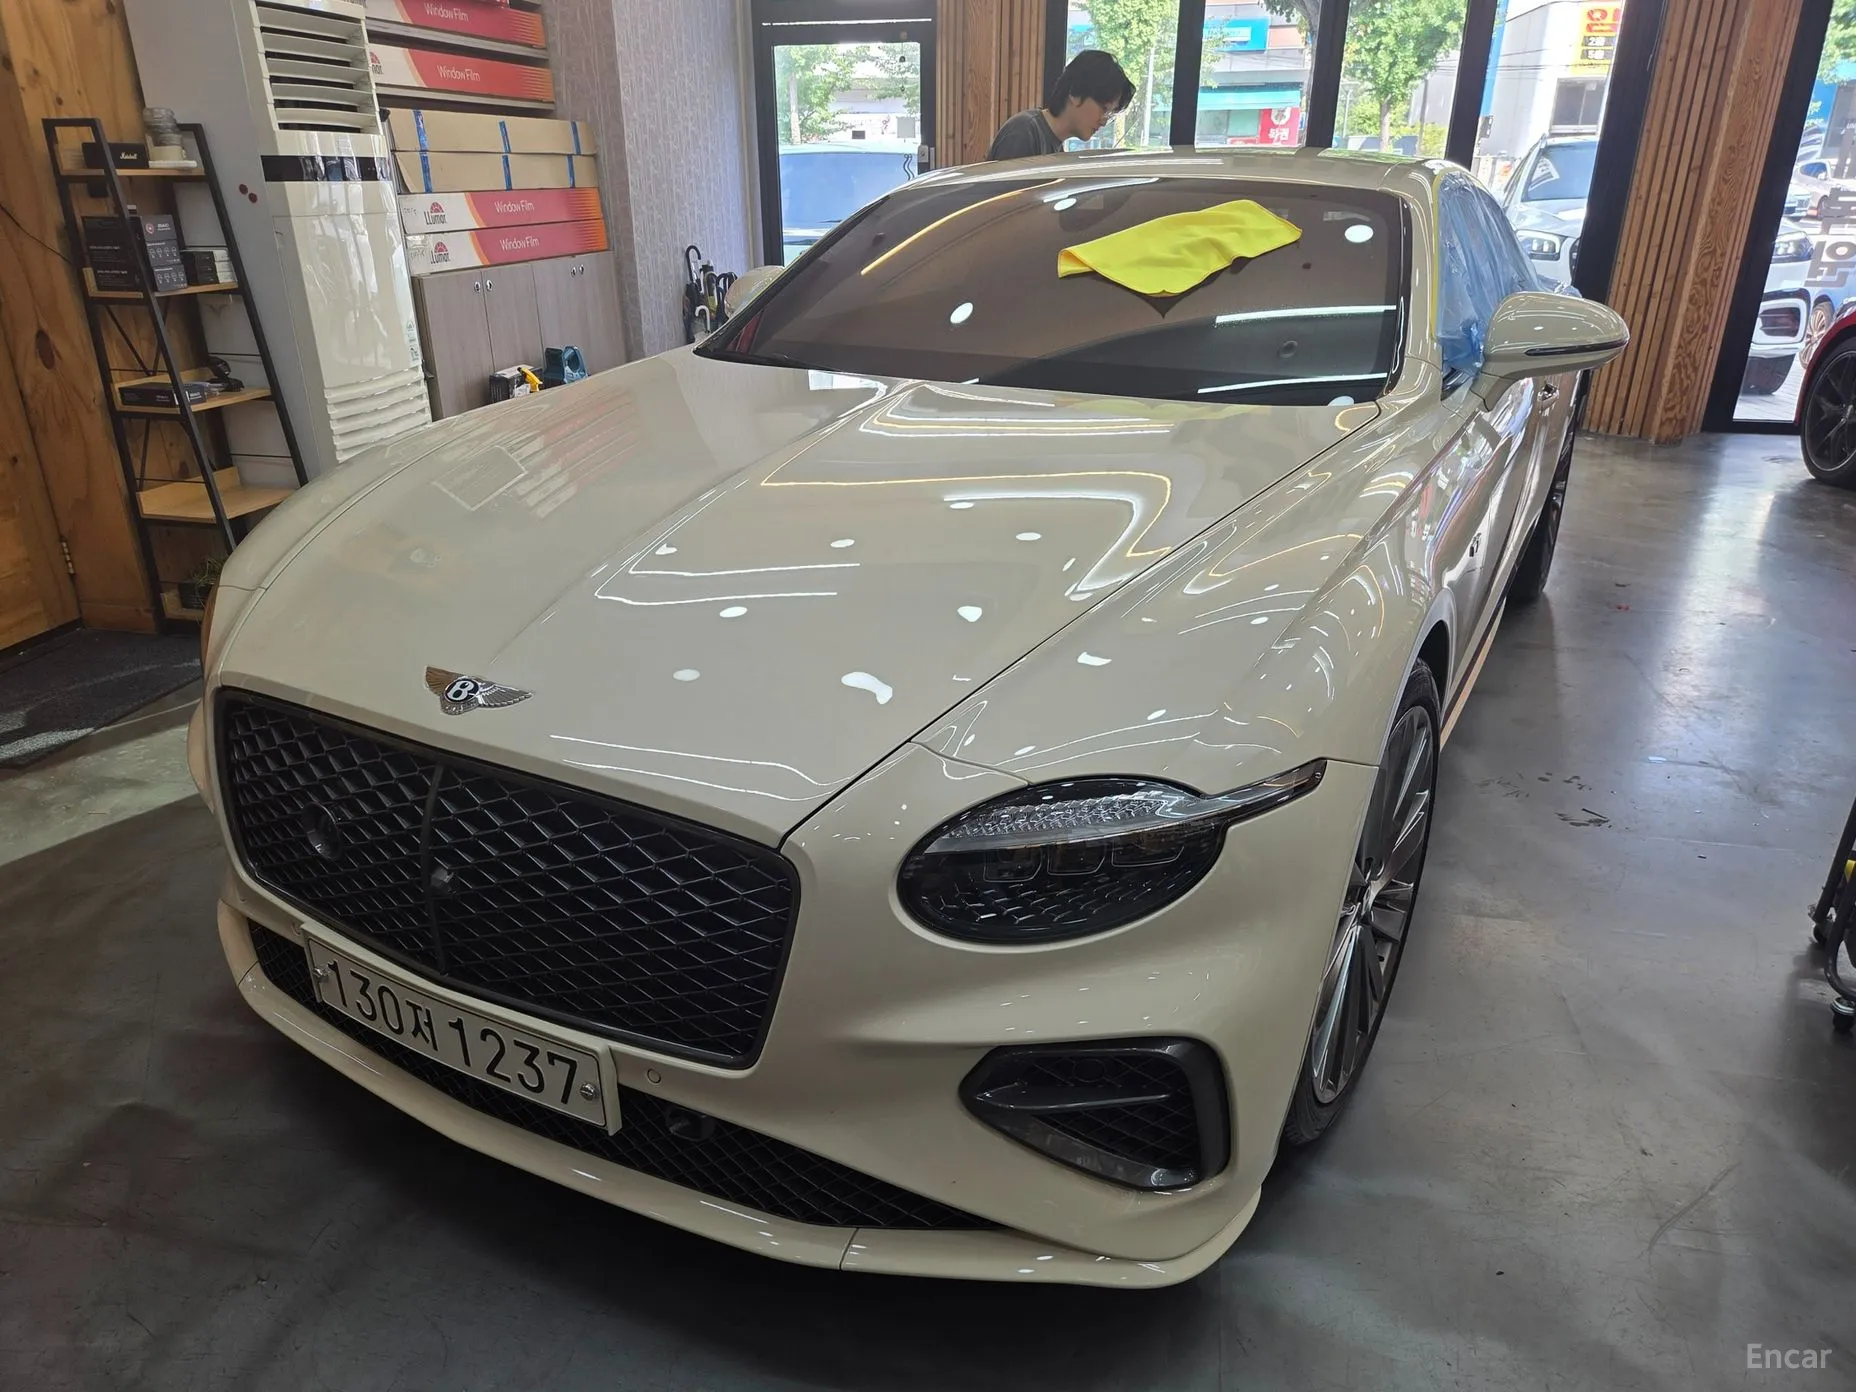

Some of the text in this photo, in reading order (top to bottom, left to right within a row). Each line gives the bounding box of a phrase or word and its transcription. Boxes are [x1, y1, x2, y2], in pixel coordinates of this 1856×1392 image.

[424, 3, 469, 22] Window Film
[436, 65, 481, 82] Window Film
[494, 202, 521, 213] Window
[520, 201, 535, 211] Film
[431, 250, 451, 264] Lumar
[500, 239, 526, 250] Window
[525, 236, 540, 246] Film
[326, 960, 578, 1105] 130저 1237
